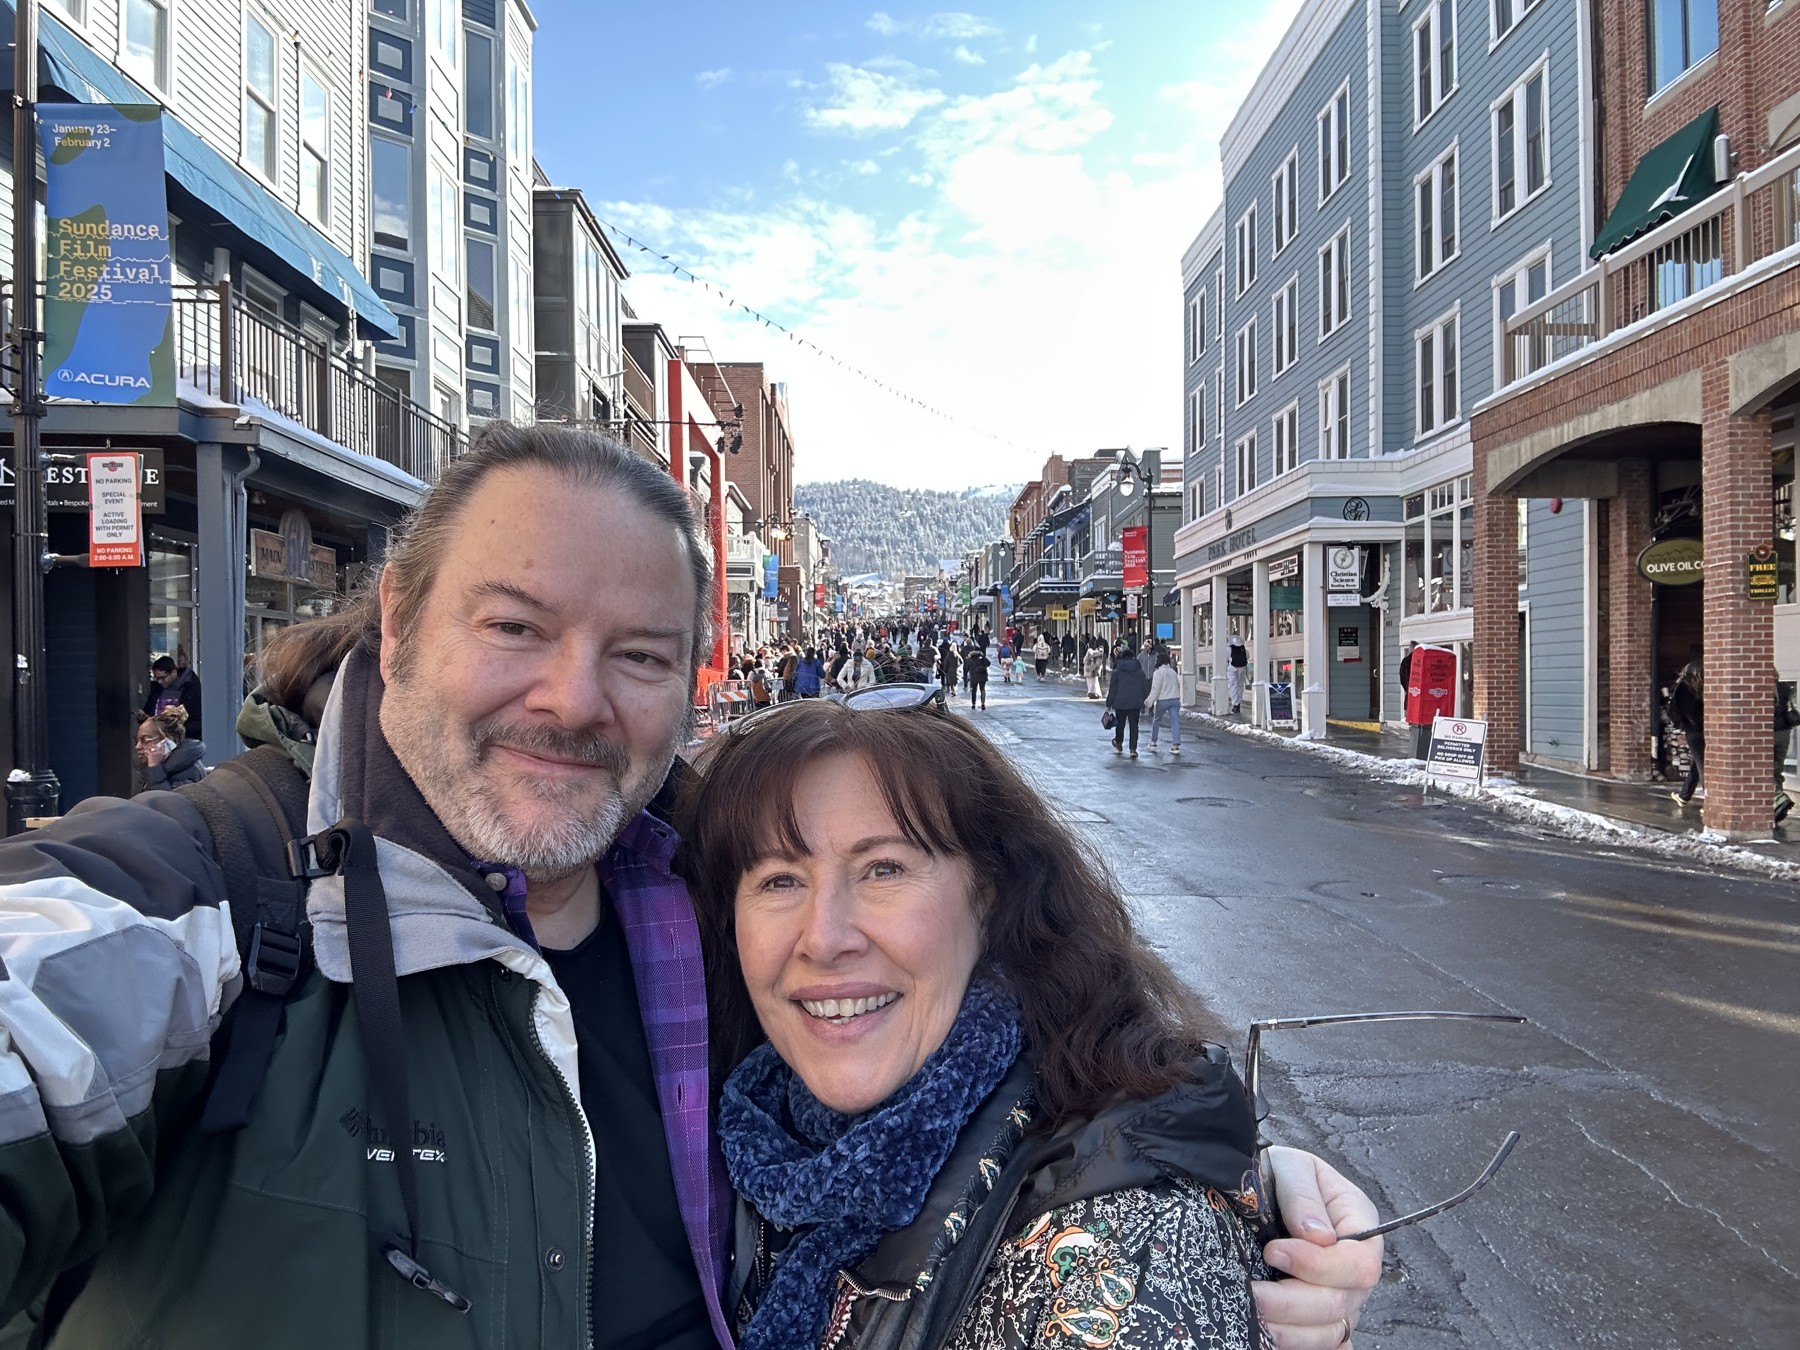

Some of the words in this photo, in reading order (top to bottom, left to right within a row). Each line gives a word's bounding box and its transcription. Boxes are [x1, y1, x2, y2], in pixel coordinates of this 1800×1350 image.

[52, 124, 95, 136] January
[54, 136, 102, 149] February
[103, 138, 111, 147] 2
[59, 218, 159, 237] Sundance
[60, 240, 112, 257] Film
[60, 261, 160, 280] Festival
[59, 282, 113, 300] 2025
[74, 372, 151, 388] ACURA
[63, 499, 89, 508] Bespoke
[1207, 540, 1226, 561] PARK
[1229, 527, 1256, 552] HOTEL
[261, 546, 283, 563] MAIN
[1646, 562, 1676, 574] OLIVE
[1676, 561, 1694, 571] OIL
